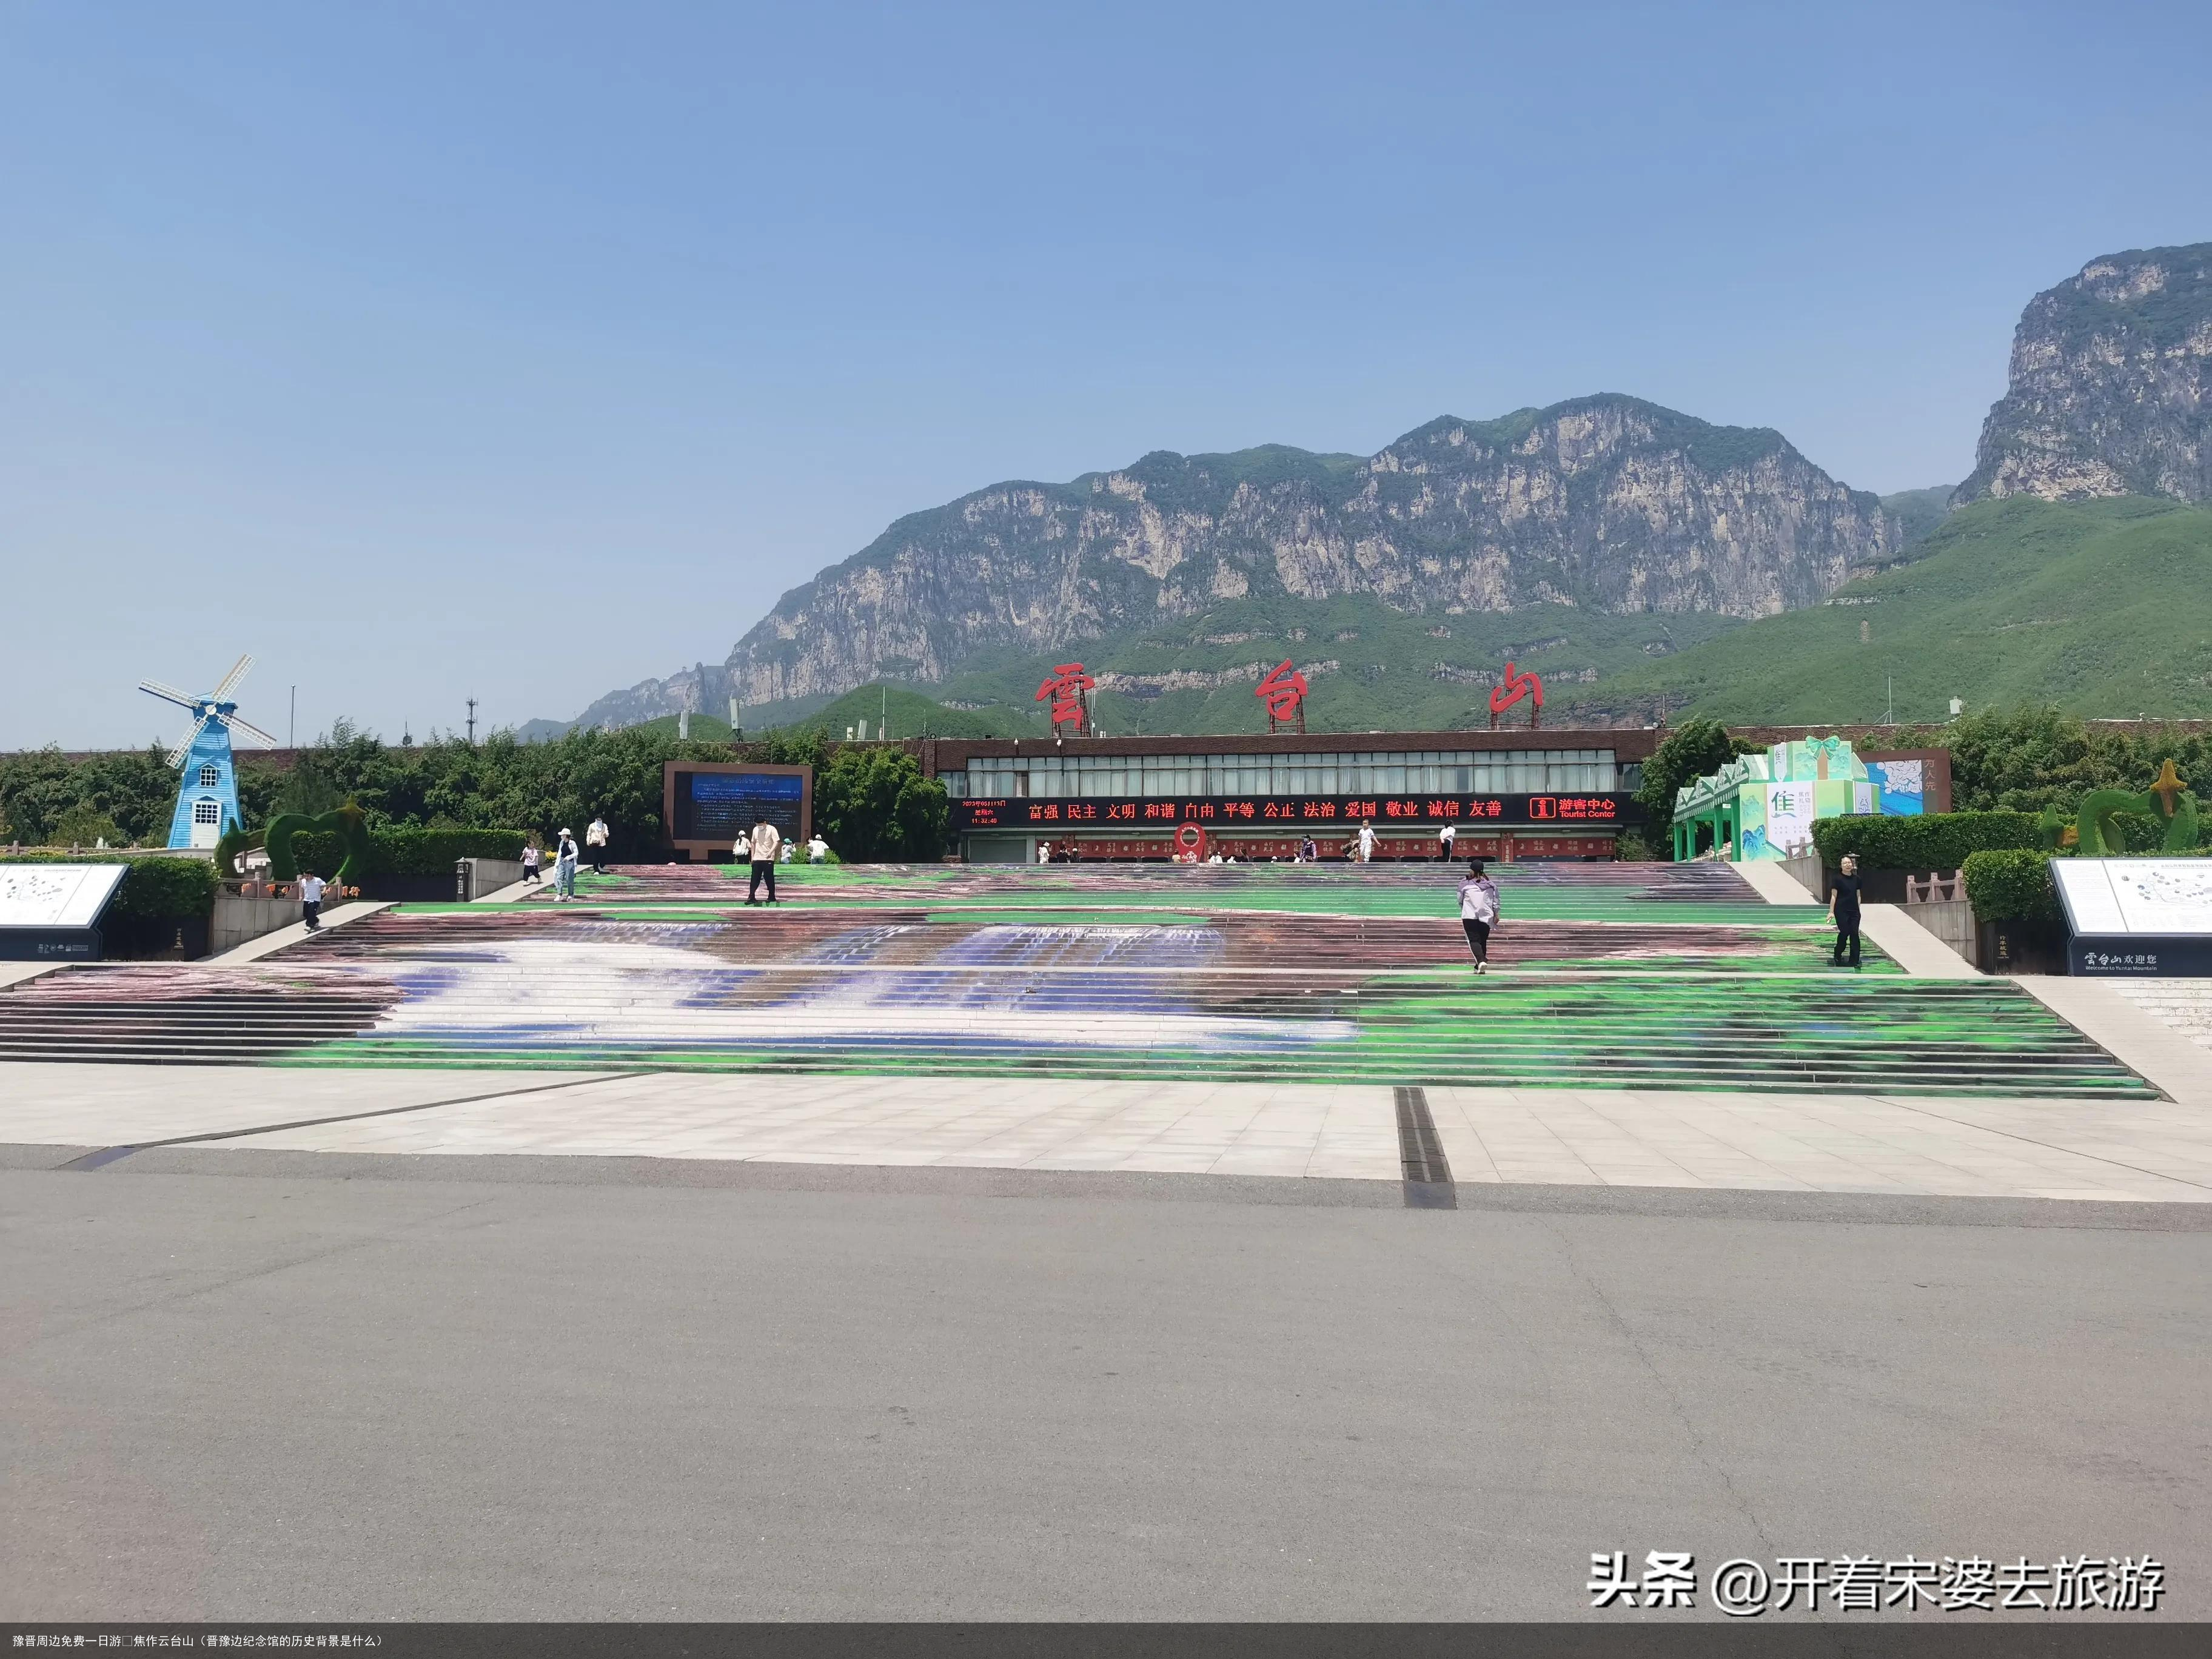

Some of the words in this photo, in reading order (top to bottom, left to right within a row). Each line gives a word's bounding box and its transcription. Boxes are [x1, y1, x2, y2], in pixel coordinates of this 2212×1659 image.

[1029, 804, 1059, 819] 富强
[1067, 805, 1096, 819] 民主
[1105, 803, 1135, 819] 文明
[1145, 803, 1175, 819] 和谐
[1224, 802, 1255, 818] 平等
[1264, 802, 1295, 818] 公正
[1304, 802, 1335, 817] 法治
[1345, 801, 1376, 817] 爱国
[1386, 801, 1418, 817] 敬业
[1427, 800, 1460, 817] 诚信
[1469, 800, 1502, 817] 友善
[1558, 799, 1615, 810] 游客中心
